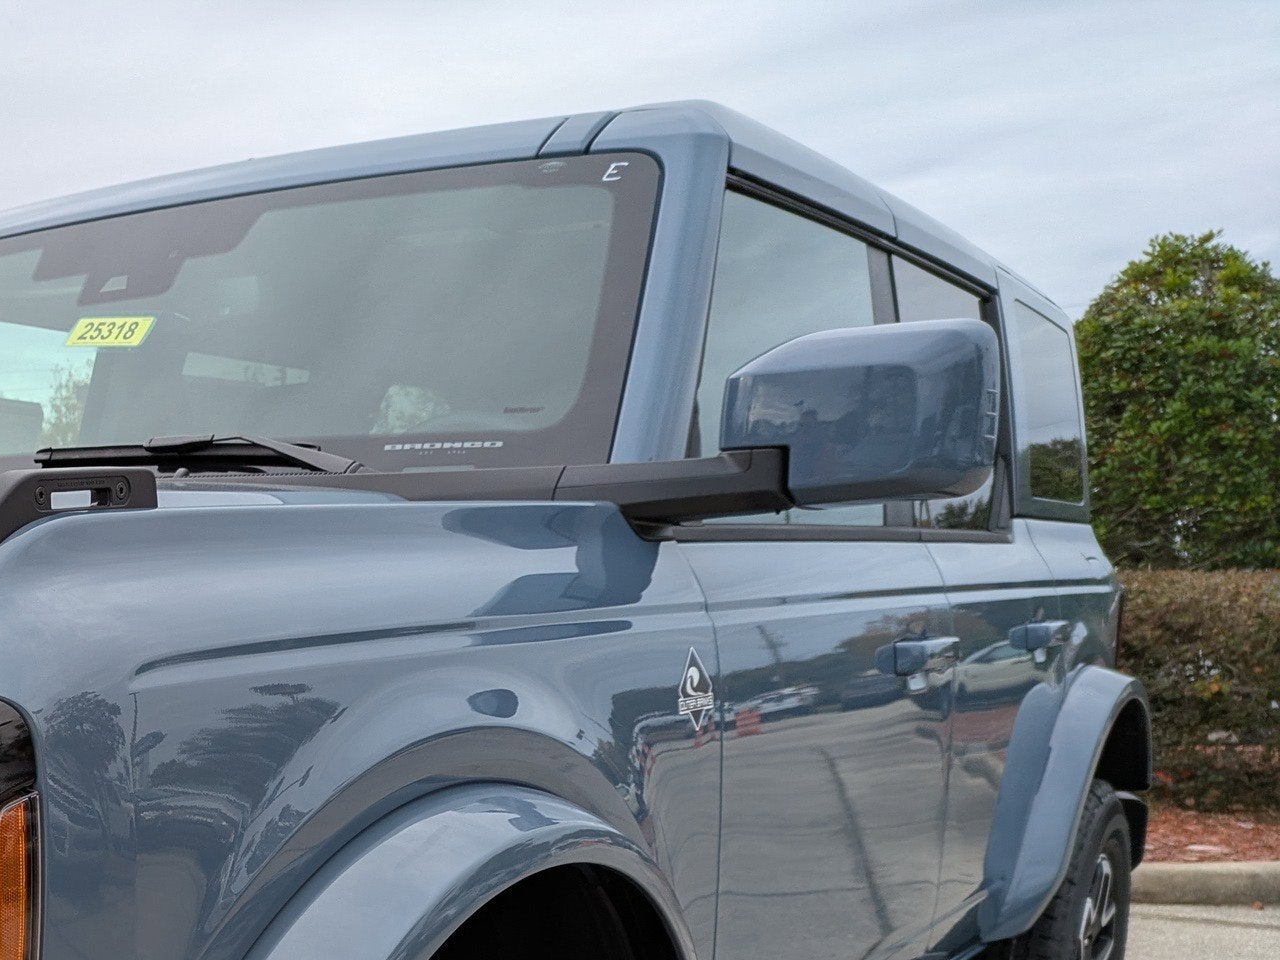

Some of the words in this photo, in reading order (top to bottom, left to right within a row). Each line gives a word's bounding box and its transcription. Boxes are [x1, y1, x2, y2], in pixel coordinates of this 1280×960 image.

[602, 161, 629, 181] E
[76, 321, 140, 342] 25318
[384, 441, 504, 451] BRONCO
